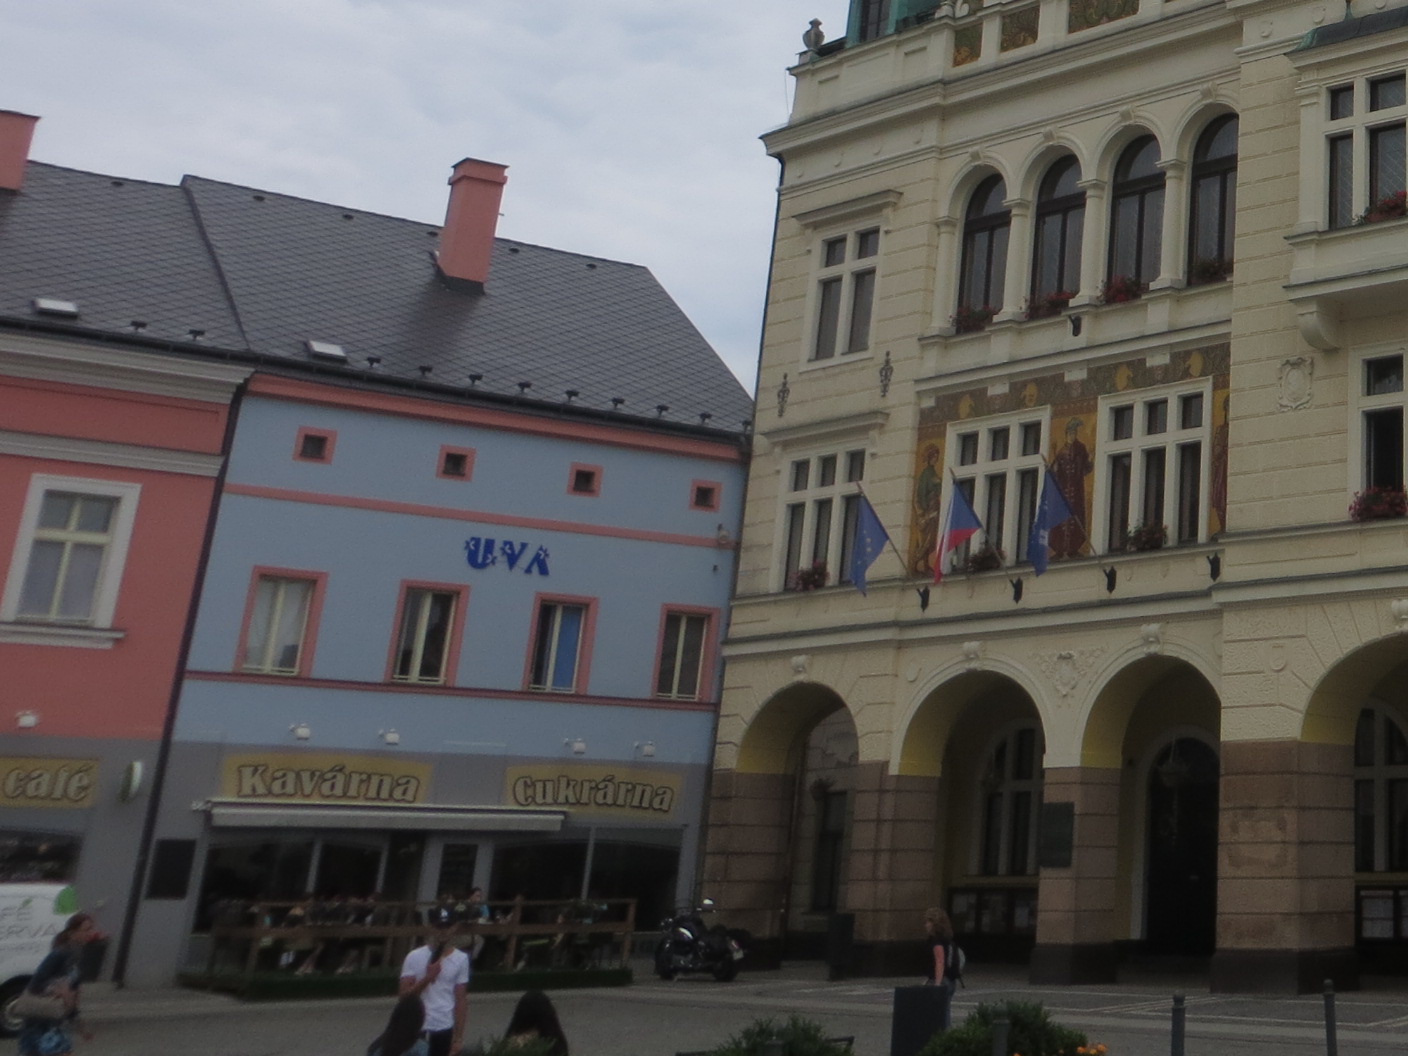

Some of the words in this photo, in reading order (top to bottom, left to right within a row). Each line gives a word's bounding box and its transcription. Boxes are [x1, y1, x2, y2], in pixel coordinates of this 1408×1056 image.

[464, 536, 550, 576] UVA
[4, 764, 91, 802] café
[237, 763, 420, 803] Kavárna
[513, 774, 674, 813] Cukrárna
